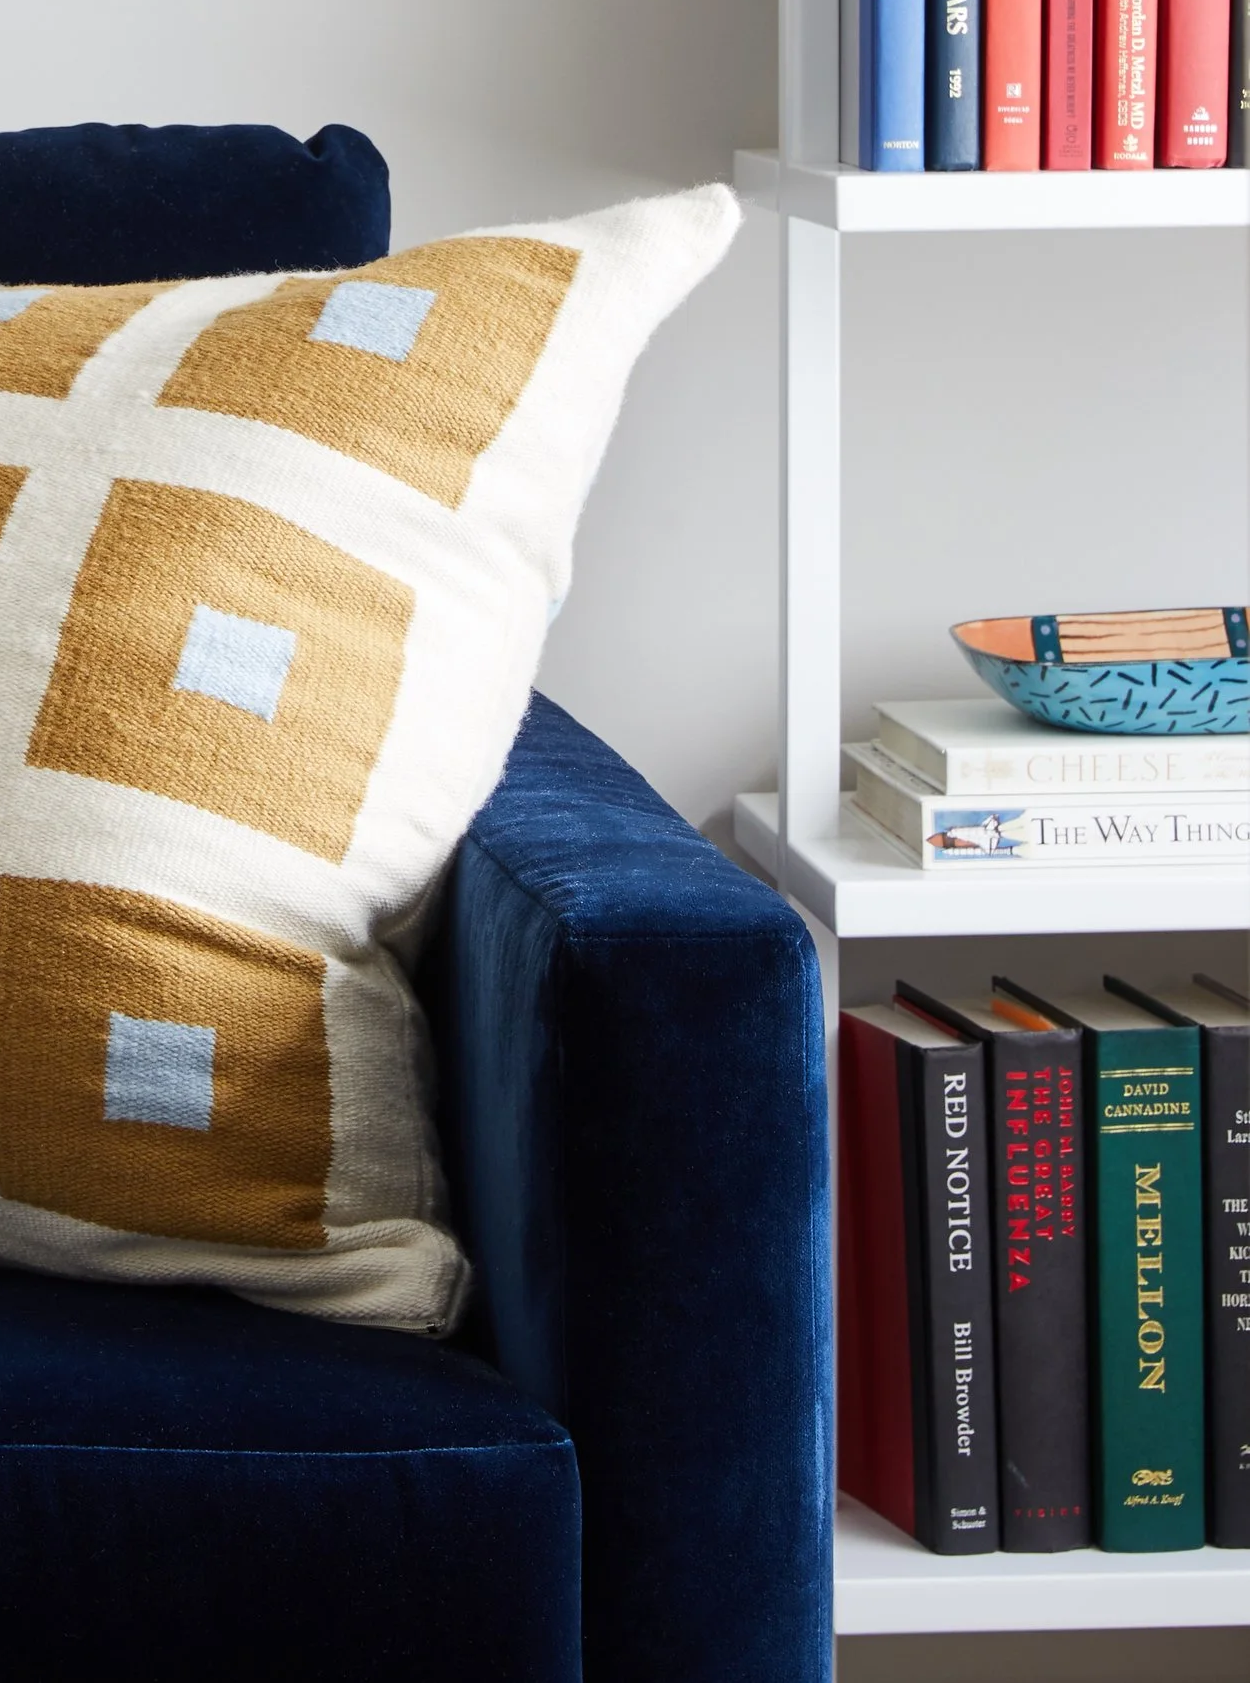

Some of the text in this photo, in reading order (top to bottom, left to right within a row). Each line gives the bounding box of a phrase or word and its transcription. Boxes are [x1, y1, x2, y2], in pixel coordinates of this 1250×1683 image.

[1118, 11, 1128, 49] Andrew
[1130, 38, 1146, 53] D.
[949, 68, 962, 99] 1992
[1129, 56, 1146, 99] Metzl,
[1129, 101, 1146, 130] MD
[883, 140, 920, 149] NORTON
[1026, 752, 1187, 783] CHEESE
[1031, 818, 1087, 846] THE
[1092, 815, 1159, 845] WAY
[1058, 1066, 1074, 1128] JOHN
[1123, 1082, 1169, 1097] DAVID
[1104, 1101, 1192, 1118] CANNADINE
[1033, 1066, 1054, 1241] THE GREAT
[1005, 1070, 1032, 1294] INFLUENZA
[1059, 1164, 1076, 1238] BARRY
[1222, 1198, 1249, 1213] THE
[943, 1072, 975, 1457] RED NOTICE Bill Browder
[1134, 1162, 1166, 1394] MELLON
[952, 1519, 987, 1530] Schuster
